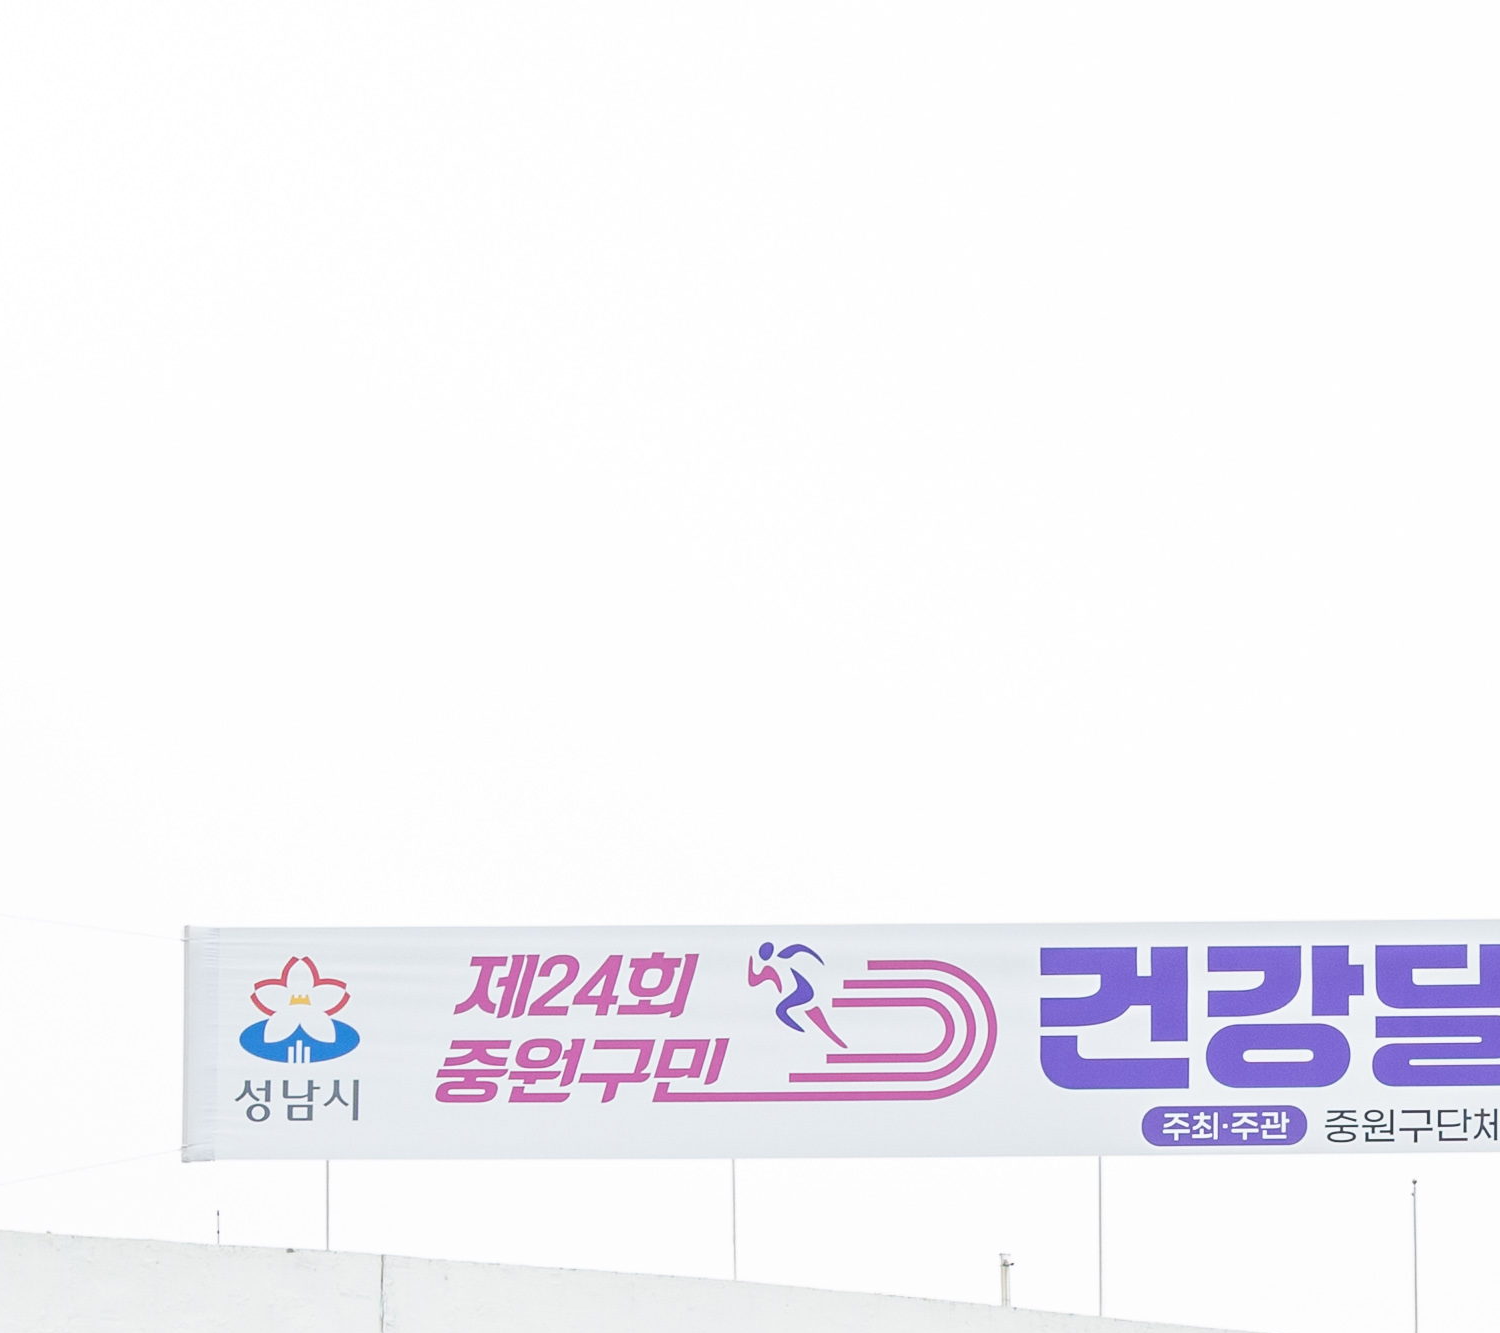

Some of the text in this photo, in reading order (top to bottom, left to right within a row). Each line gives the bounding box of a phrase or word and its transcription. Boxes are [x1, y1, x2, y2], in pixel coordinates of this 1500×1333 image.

[454, 952, 699, 1018] 제24회
[435, 1038, 731, 1104] 중원구민
[235, 1079, 360, 1122] 성남시
[1162, 1112, 1290, 1141] 주최·주관
